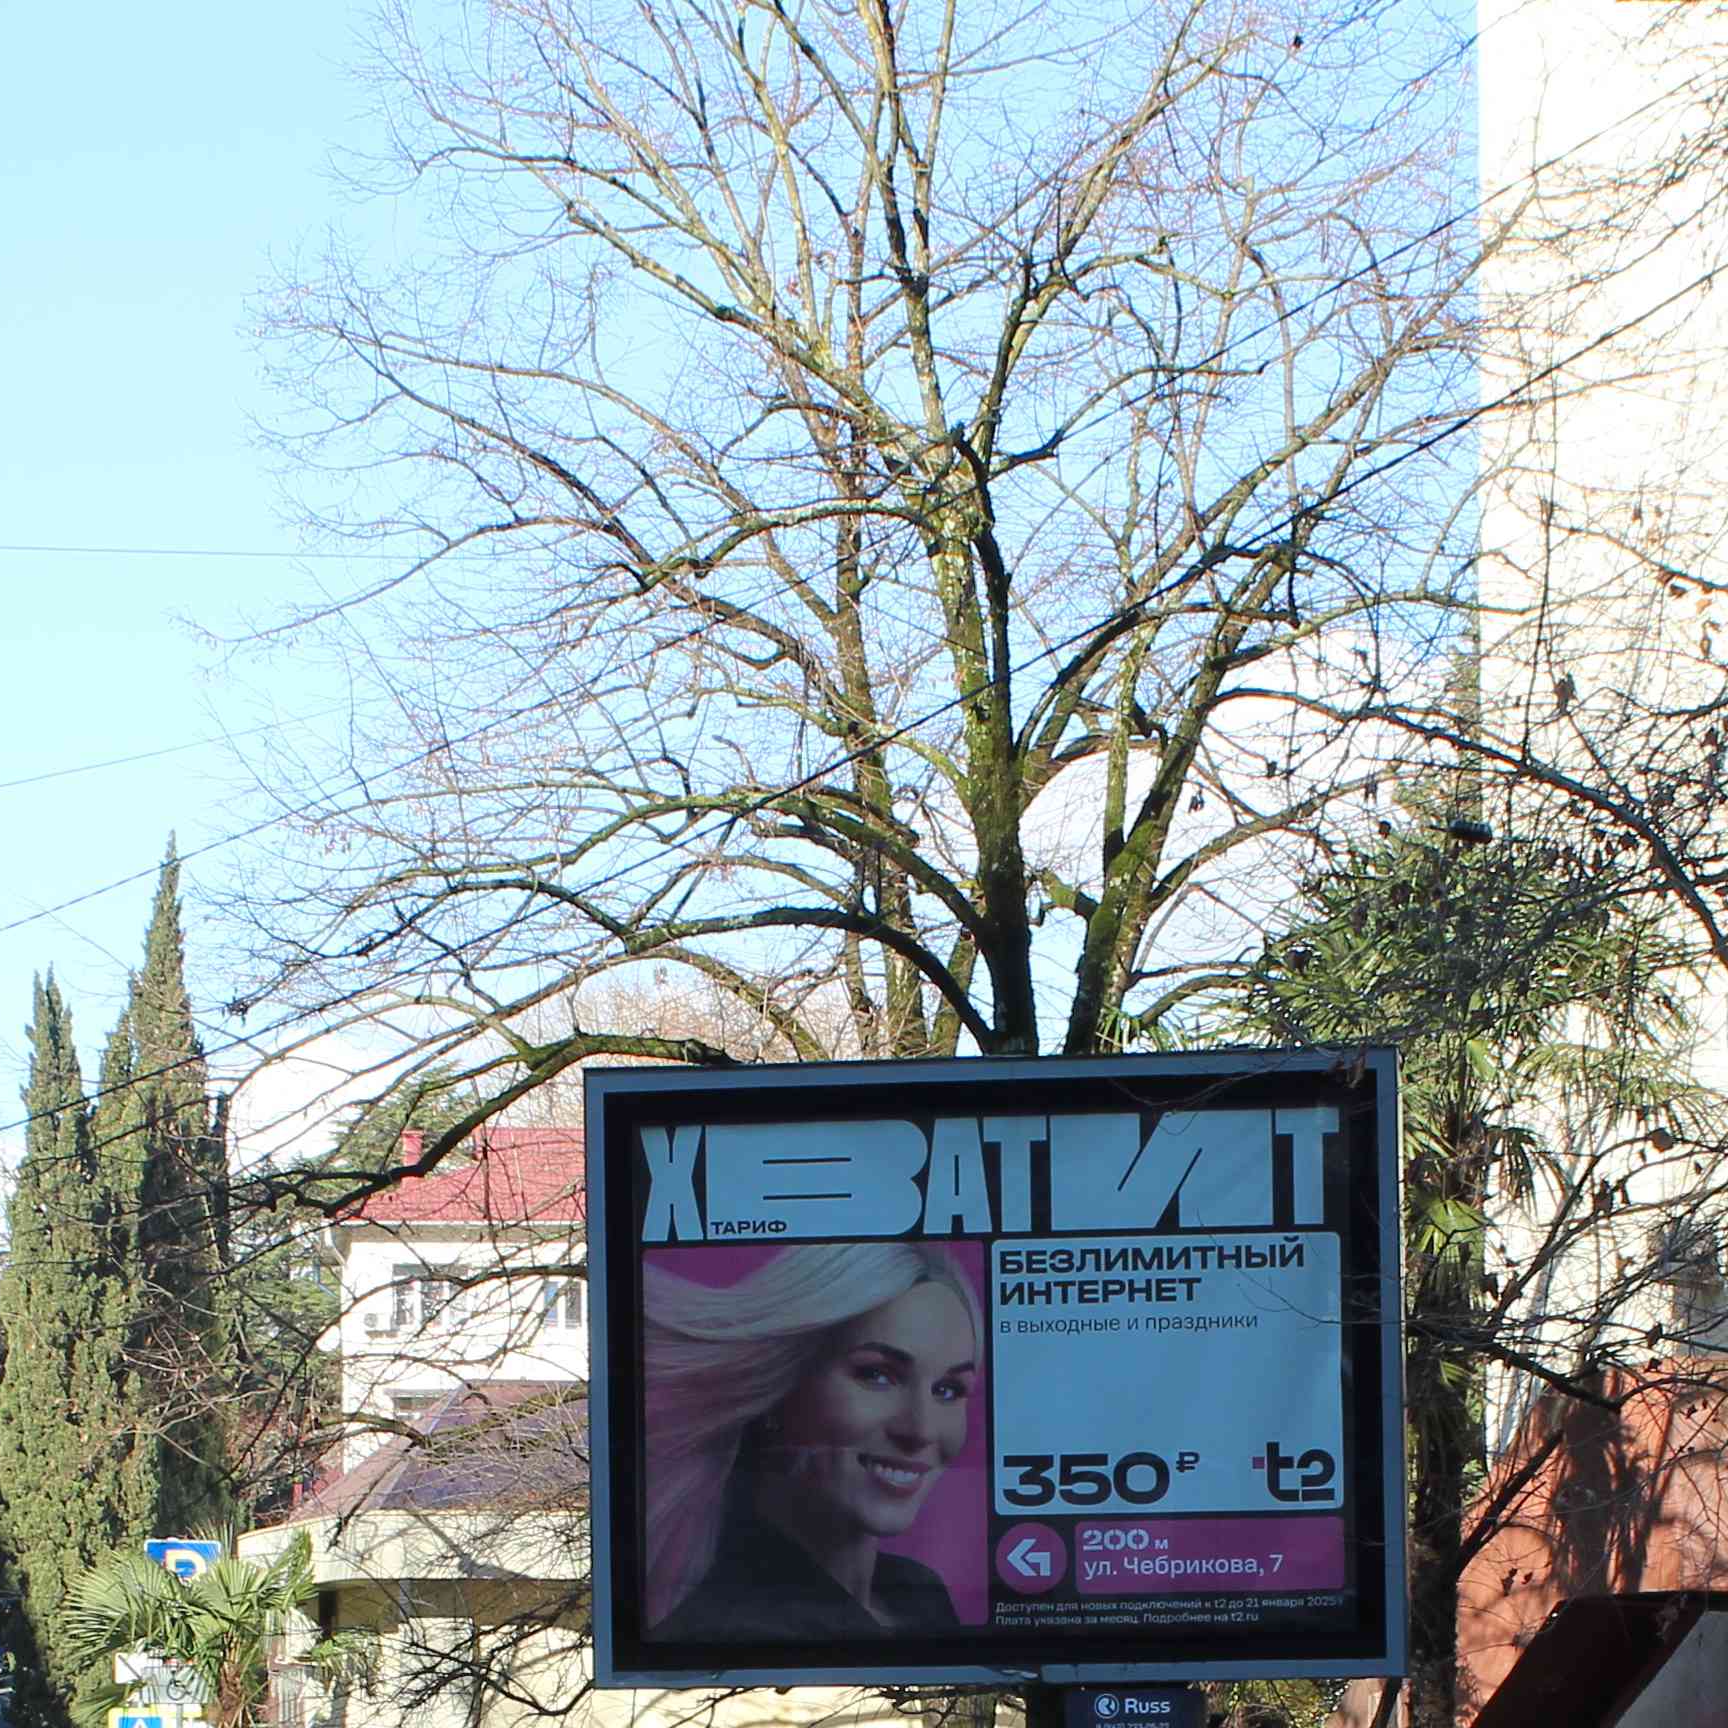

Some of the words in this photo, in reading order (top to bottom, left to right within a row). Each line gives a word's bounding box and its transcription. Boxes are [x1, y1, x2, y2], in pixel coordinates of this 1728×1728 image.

[640, 1108, 1340, 1241] ХВАТИТ
[711, 1219, 788, 1236] ТАРИФ
[999, 1235, 1305, 1275] БЕЗЛИМИТНЫЙ
[999, 1277, 1202, 1306] ИНТЕРНЕТ
[1000, 1320, 1012, 1333] в
[1018, 1317, 1120, 1336] выходные
[1127, 1317, 1140, 1330] и
[1145, 1313, 1259, 1333] праздники
[1252, 1441, 1336, 1503] t2
[1082, 1528, 1150, 1551] 200
[1155, 1538, 1169, 1550] м
[1084, 1558, 1118, 1580] ул.
[1123, 1555, 1265, 1579] Чебрикова,
[1269, 1555, 1284, 1573] 7
[996, 1601, 1054, 1613] Доступен
[1056, 1601, 1079, 1612] для
[1080, 1600, 1118, 1612] новых
[1119, 1598, 1203, 1611] подключений
[1214, 1598, 1227, 1609] t2
[1228, 1600, 1244, 1611] до
[1245, 1597, 1259, 1608] 21
[1261, 1599, 1305, 1610] января
[995, 1613, 1032, 1625] Плата
[1033, 1615, 1083, 1627] указана
[1085, 1616, 1099, 1625] за
[1143, 1612, 1212, 1626] Подробнее
[1213, 1613, 1228, 1623] на
[1230, 1611, 1259, 1623] t2.ru
[1124, 1698, 1171, 1714] Russ
